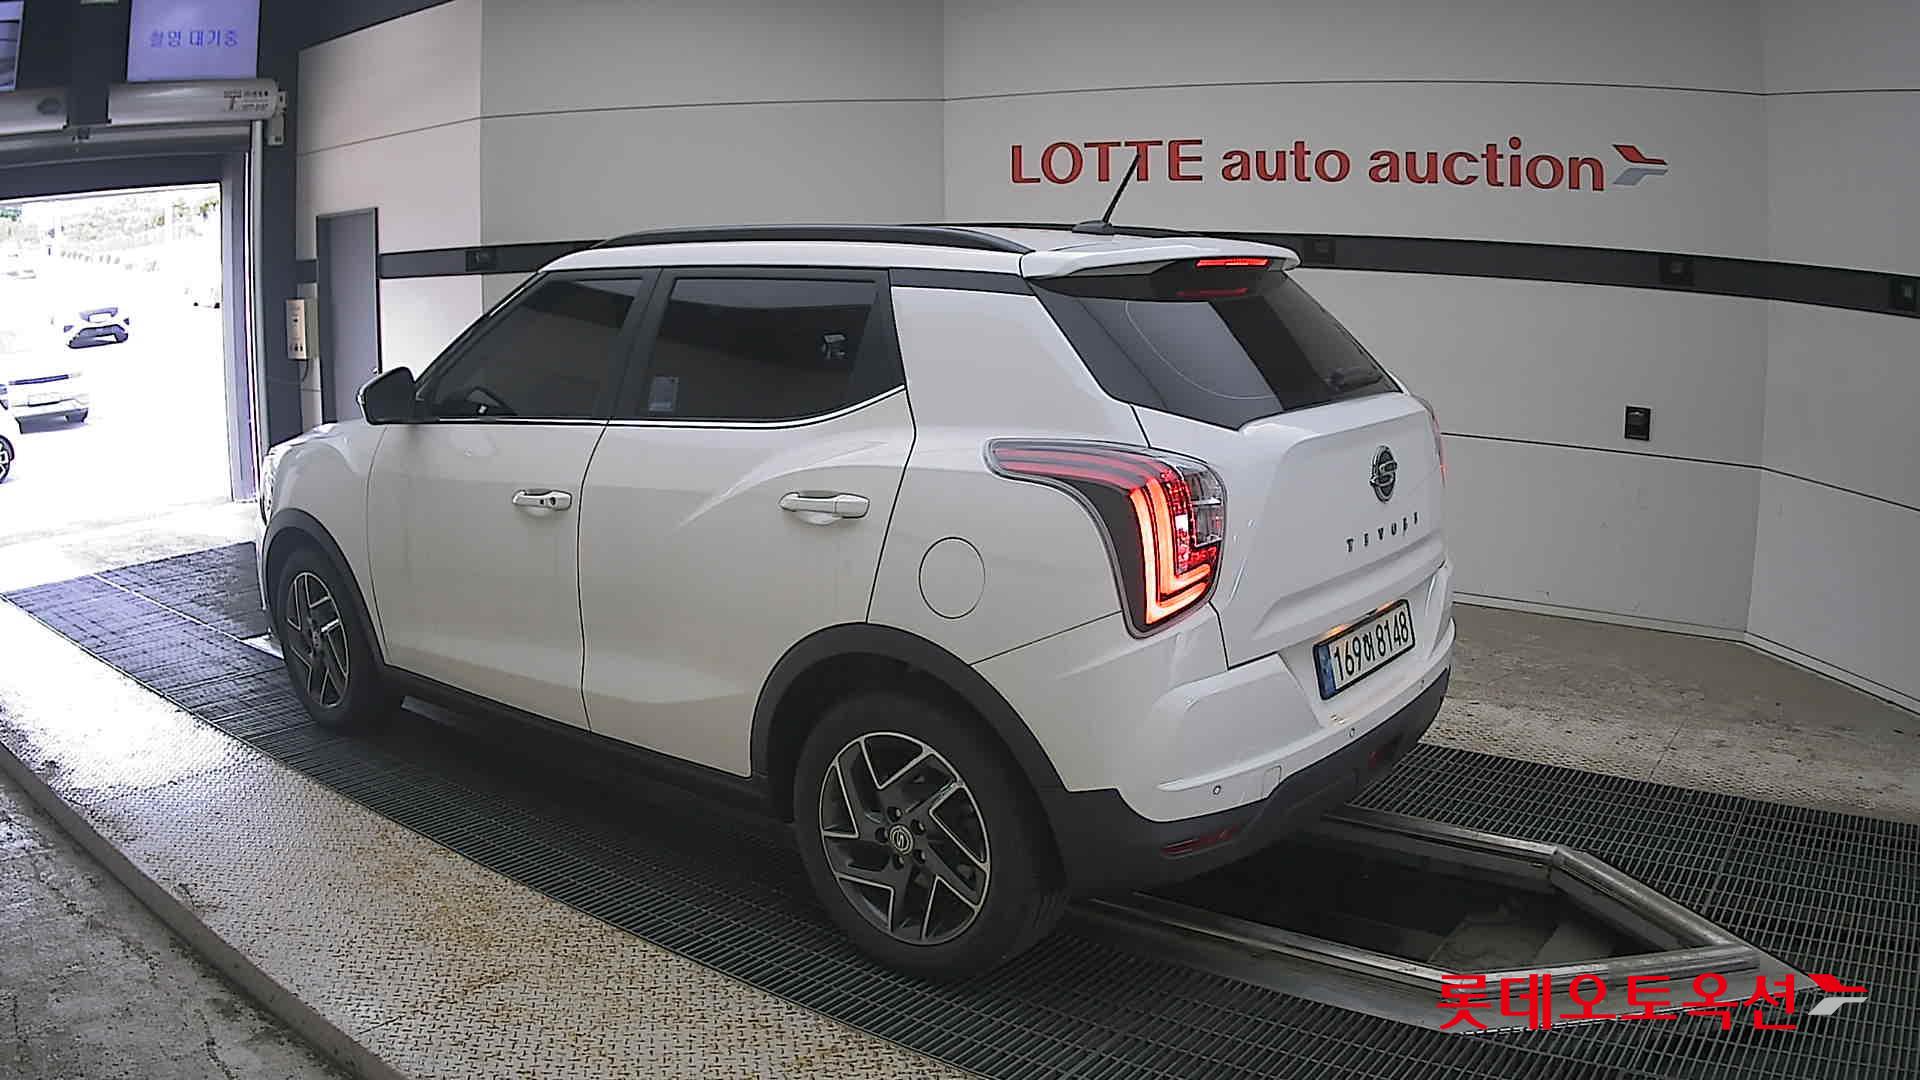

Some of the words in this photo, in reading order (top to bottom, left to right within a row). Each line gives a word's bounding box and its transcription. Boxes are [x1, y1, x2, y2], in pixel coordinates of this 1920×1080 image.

[189, 29, 239, 47] 대기중
[1011, 140, 1202, 184] LOTTE
[1221, 141, 1350, 183] auto
[1368, 136, 1605, 192] auction
